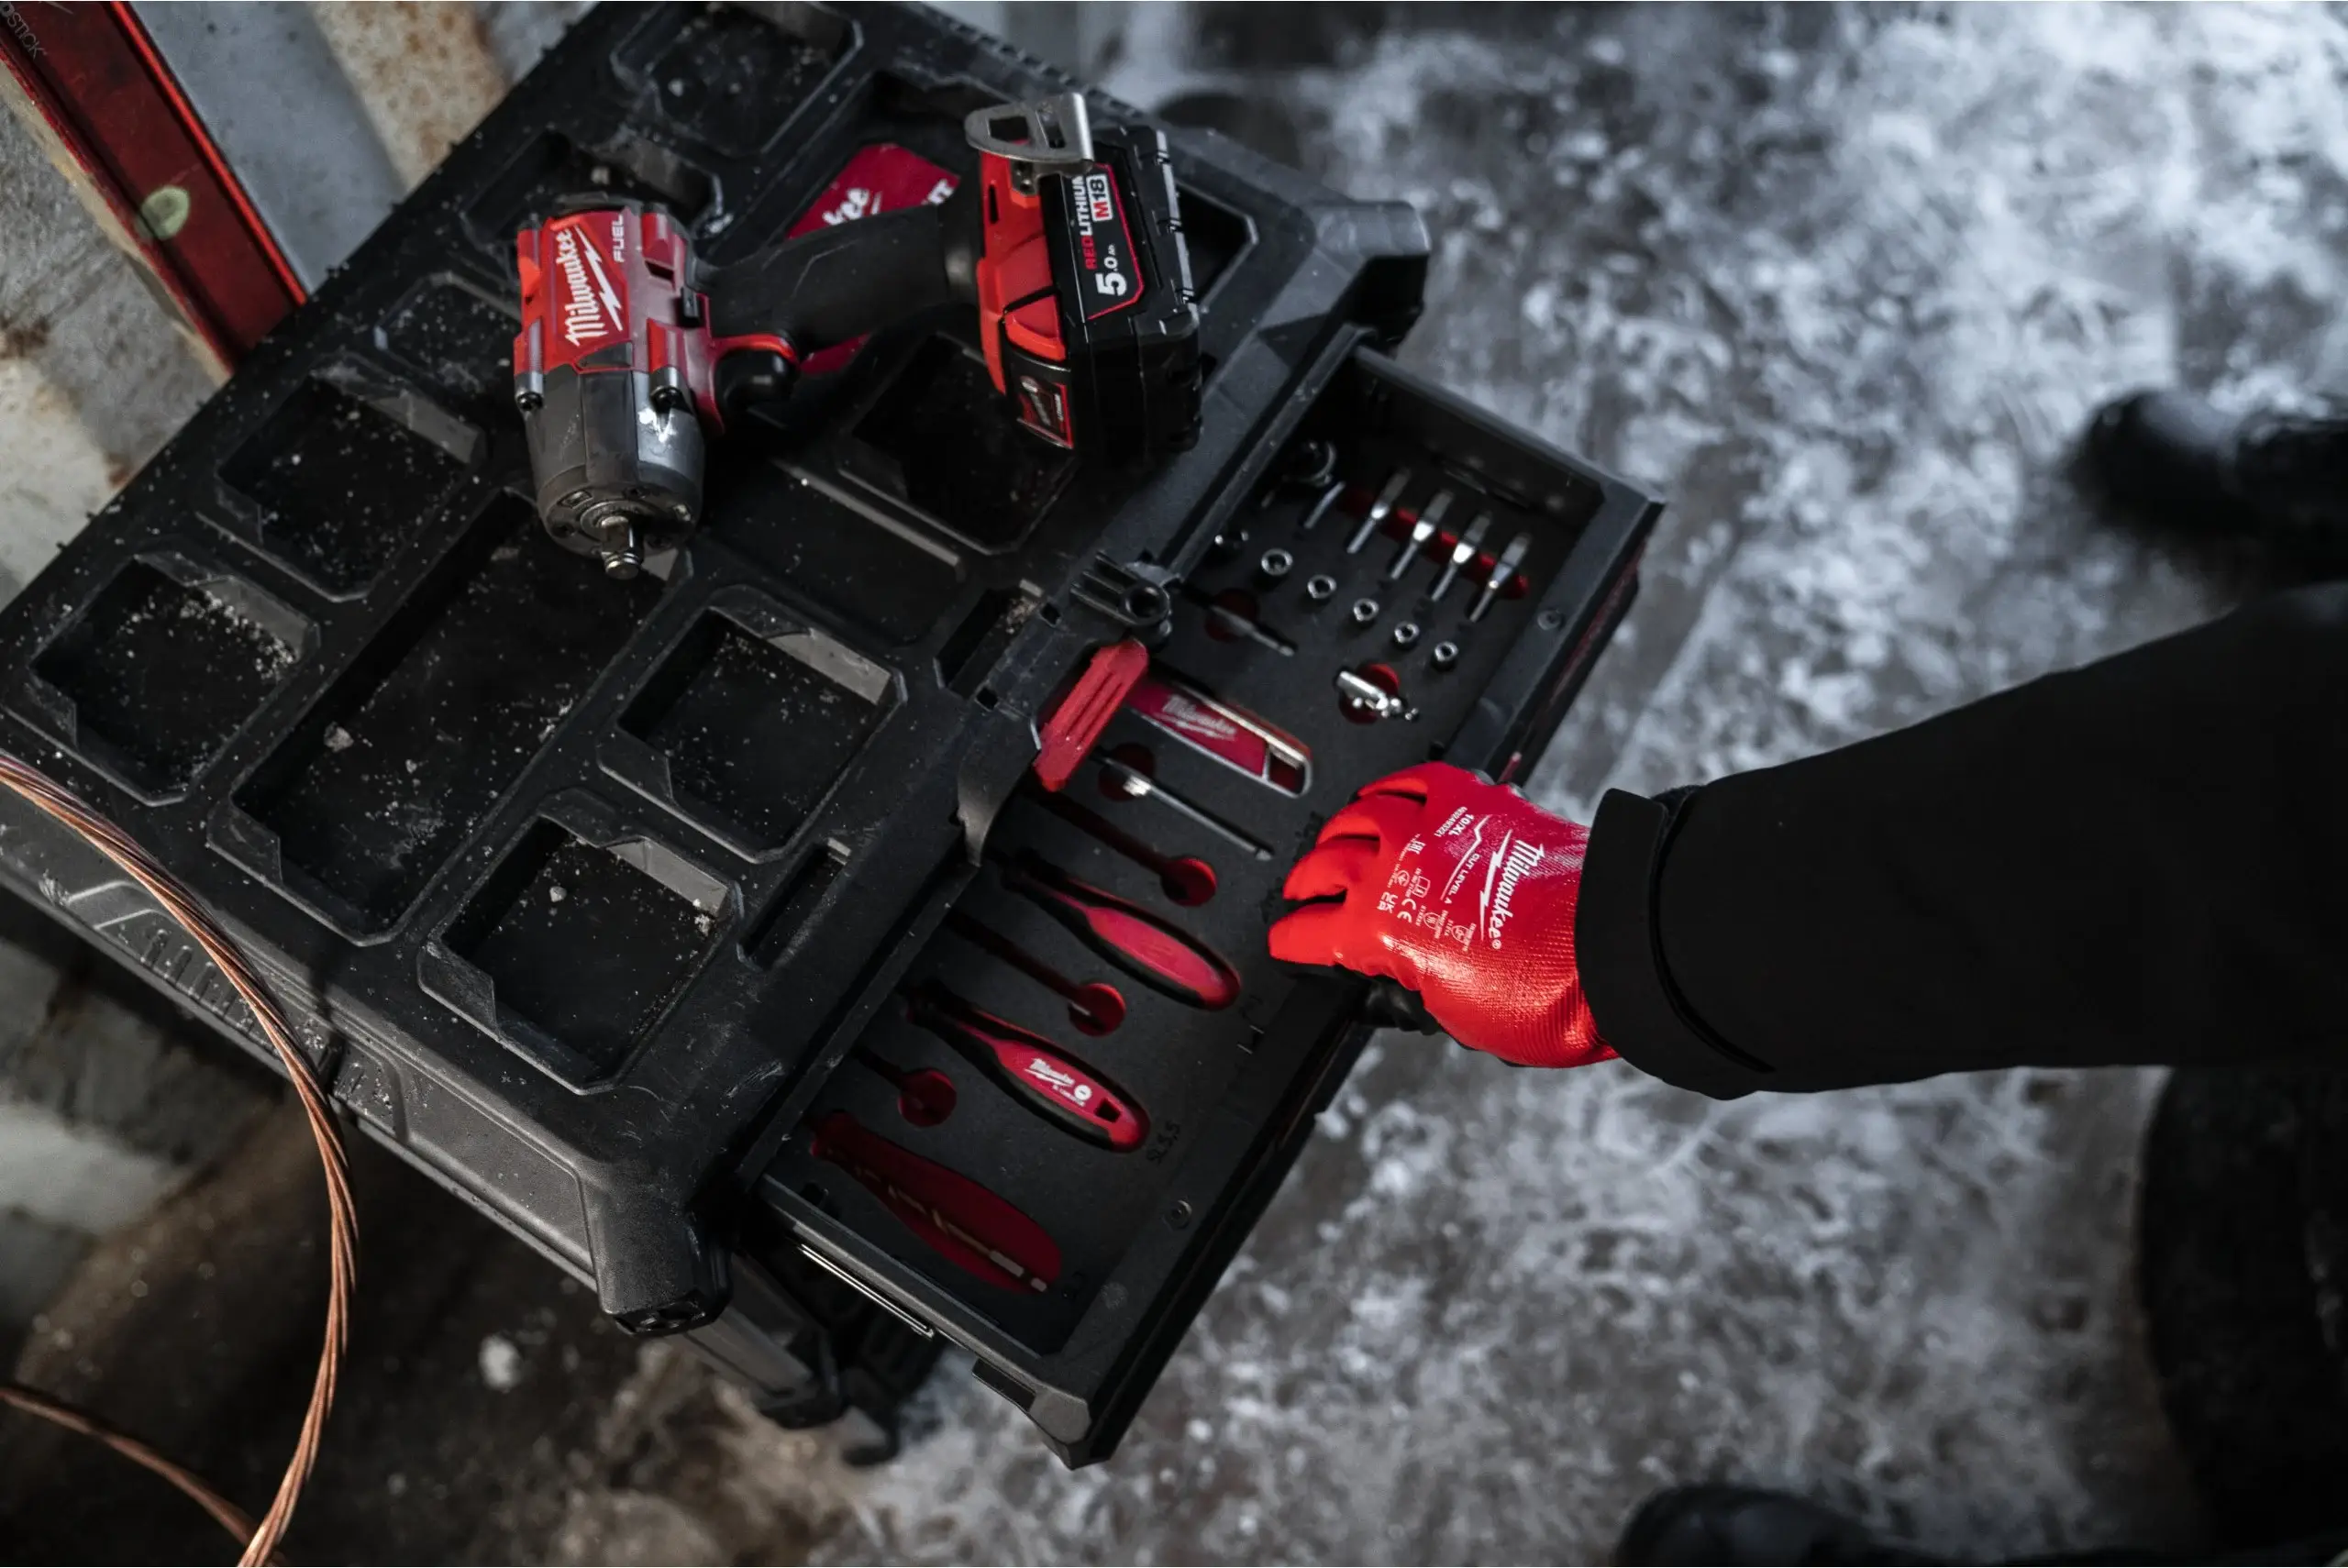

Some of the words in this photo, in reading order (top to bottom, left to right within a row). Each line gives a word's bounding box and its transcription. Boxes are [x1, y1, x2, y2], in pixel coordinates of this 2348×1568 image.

[1089, 179, 1110, 221] M18
[611, 214, 626, 264] FUEL
[555, 228, 609, 348] Milwaukee
[1095, 257, 1128, 297] 5.0
[1465, 852, 1481, 870] CUT
[1444, 896, 1453, 904] A
[1447, 868, 1469, 896] LEVEL
